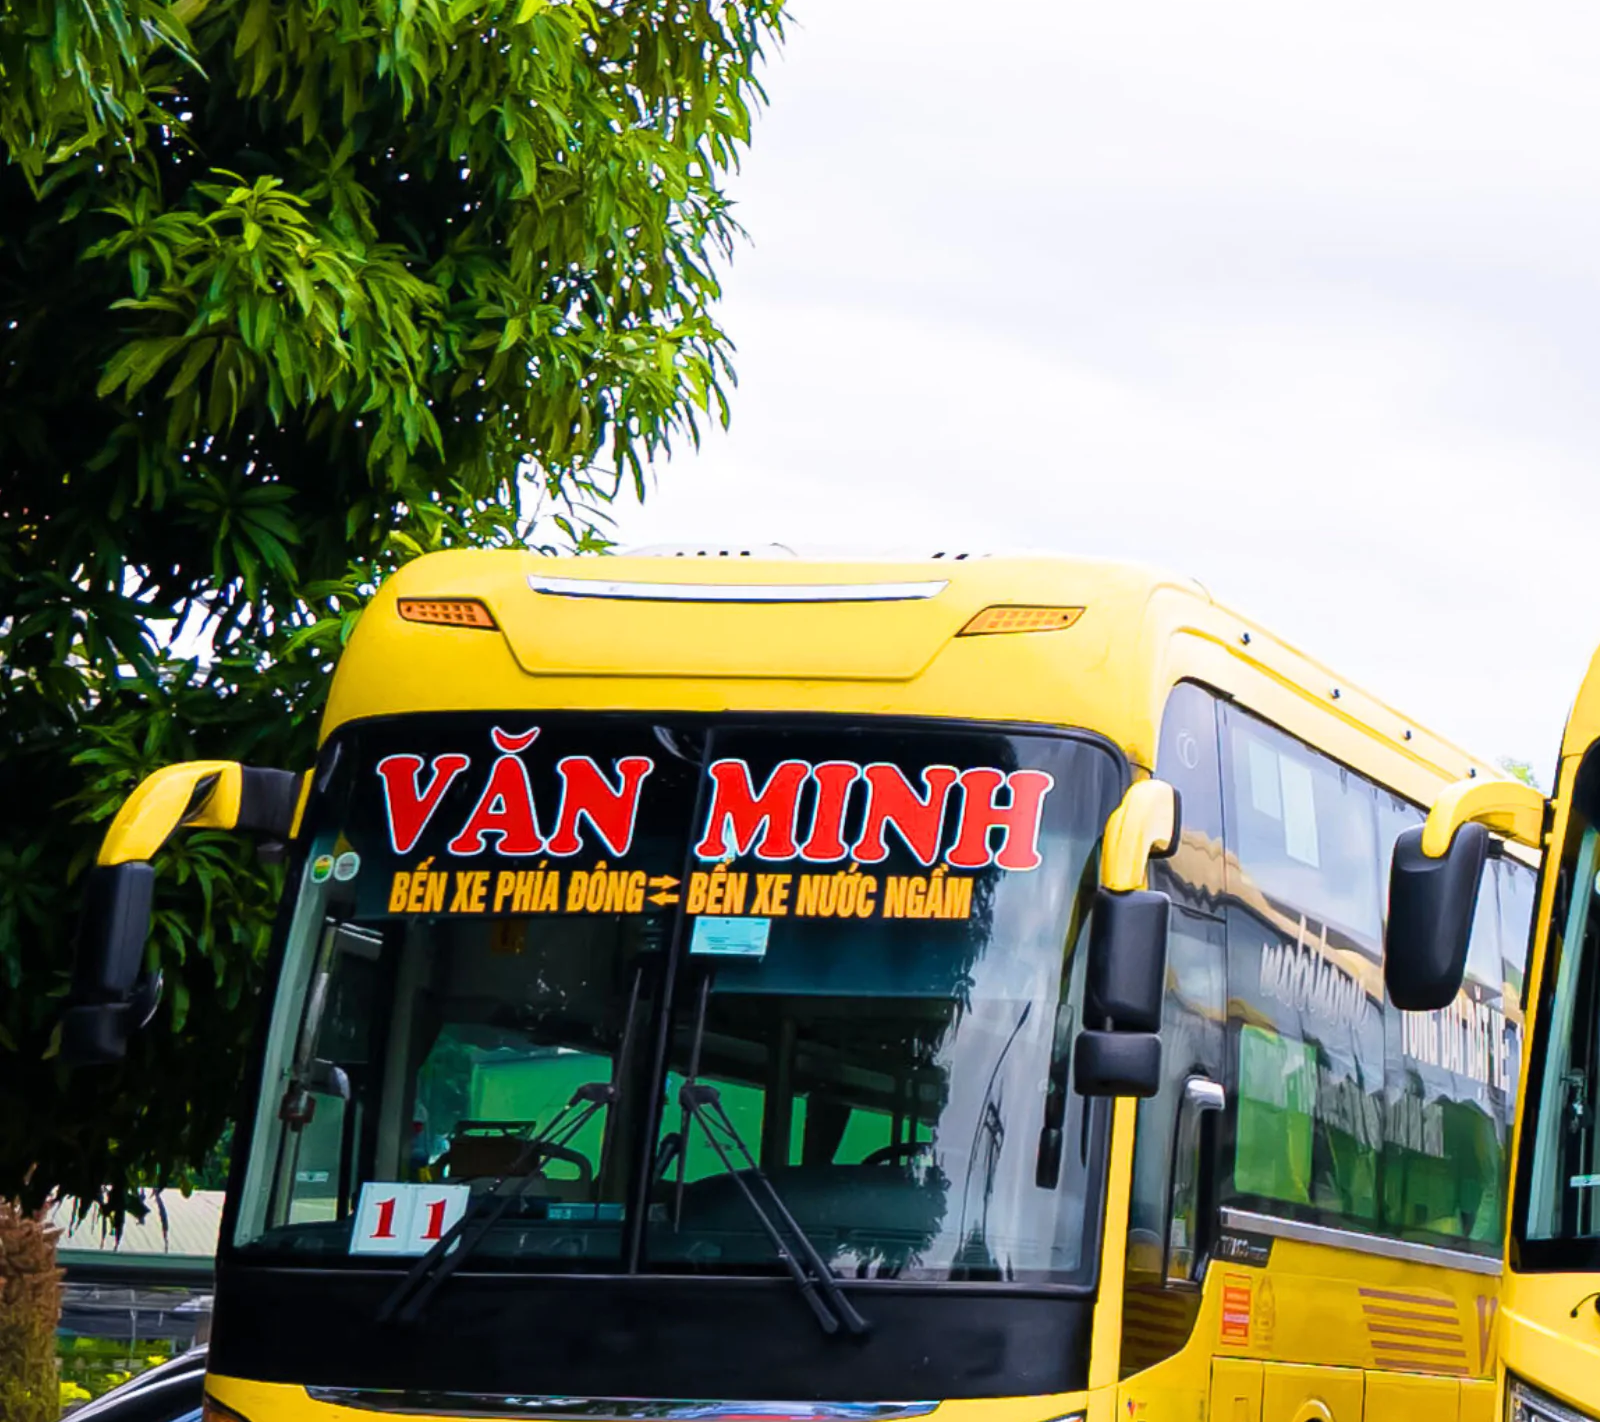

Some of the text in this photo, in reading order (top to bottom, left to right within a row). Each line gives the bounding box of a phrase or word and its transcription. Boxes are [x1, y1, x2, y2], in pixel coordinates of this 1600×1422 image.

[376, 726, 1054, 871] VĂN MINH
[388, 855, 448, 913] BẾN
[449, 871, 490, 913] XE
[493, 859, 560, 913] PHÍA
[566, 860, 647, 914] ĐÔNG
[686, 857, 748, 914] BẾN
[750, 874, 792, 916] XE
[795, 862, 877, 917] NƯỚC
